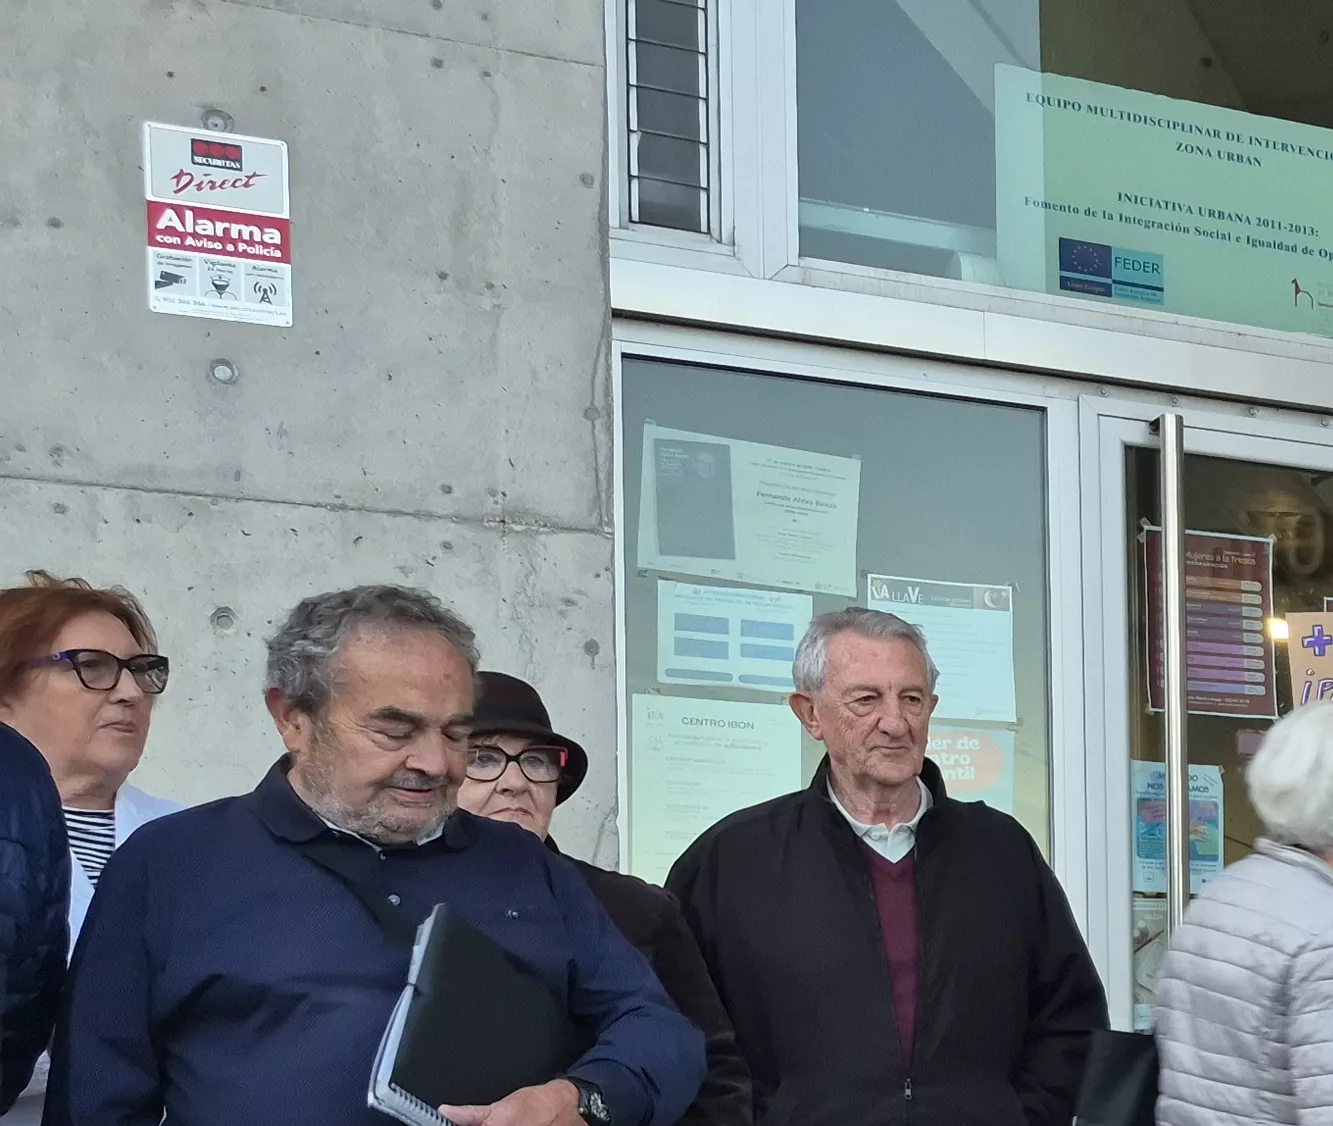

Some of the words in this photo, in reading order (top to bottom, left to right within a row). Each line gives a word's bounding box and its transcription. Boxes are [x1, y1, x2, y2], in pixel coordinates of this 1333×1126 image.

[1026, 91, 1082, 113] EQUIPO
[1086, 103, 1222, 141] MULTIDISCIPLINAR
[1226, 131, 1245, 145] DE
[193, 156, 241, 169] SECURITAS
[1175, 141, 1213, 159] ZONA
[1217, 150, 1263, 168] URBAN
[170, 168, 268, 194] Direct
[156, 208, 282, 244] Alarma
[1024, 195, 1080, 215] Fomento
[1083, 206, 1098, 218] de
[1102, 209, 1115, 221] la
[1118, 212, 1190, 235] Integración
[1194, 226, 1231, 242] Social
[1235, 236, 1242, 244] e
[1246, 235, 1297, 254] Igualdad
[1301, 245, 1315, 257] de
[1117, 191, 1194, 216] INICIATIVA
[1198, 205, 1252, 226] URBANA
[1255, 216, 1320, 238] 2011-2013:
[156, 234, 181, 244] con
[185, 238, 223, 250] Aviso
[238, 243, 282, 257] Policía
[1114, 256, 1161, 275] FEDER
[681, 716, 726, 729] CENTRO
[956, 737, 980, 750] de
